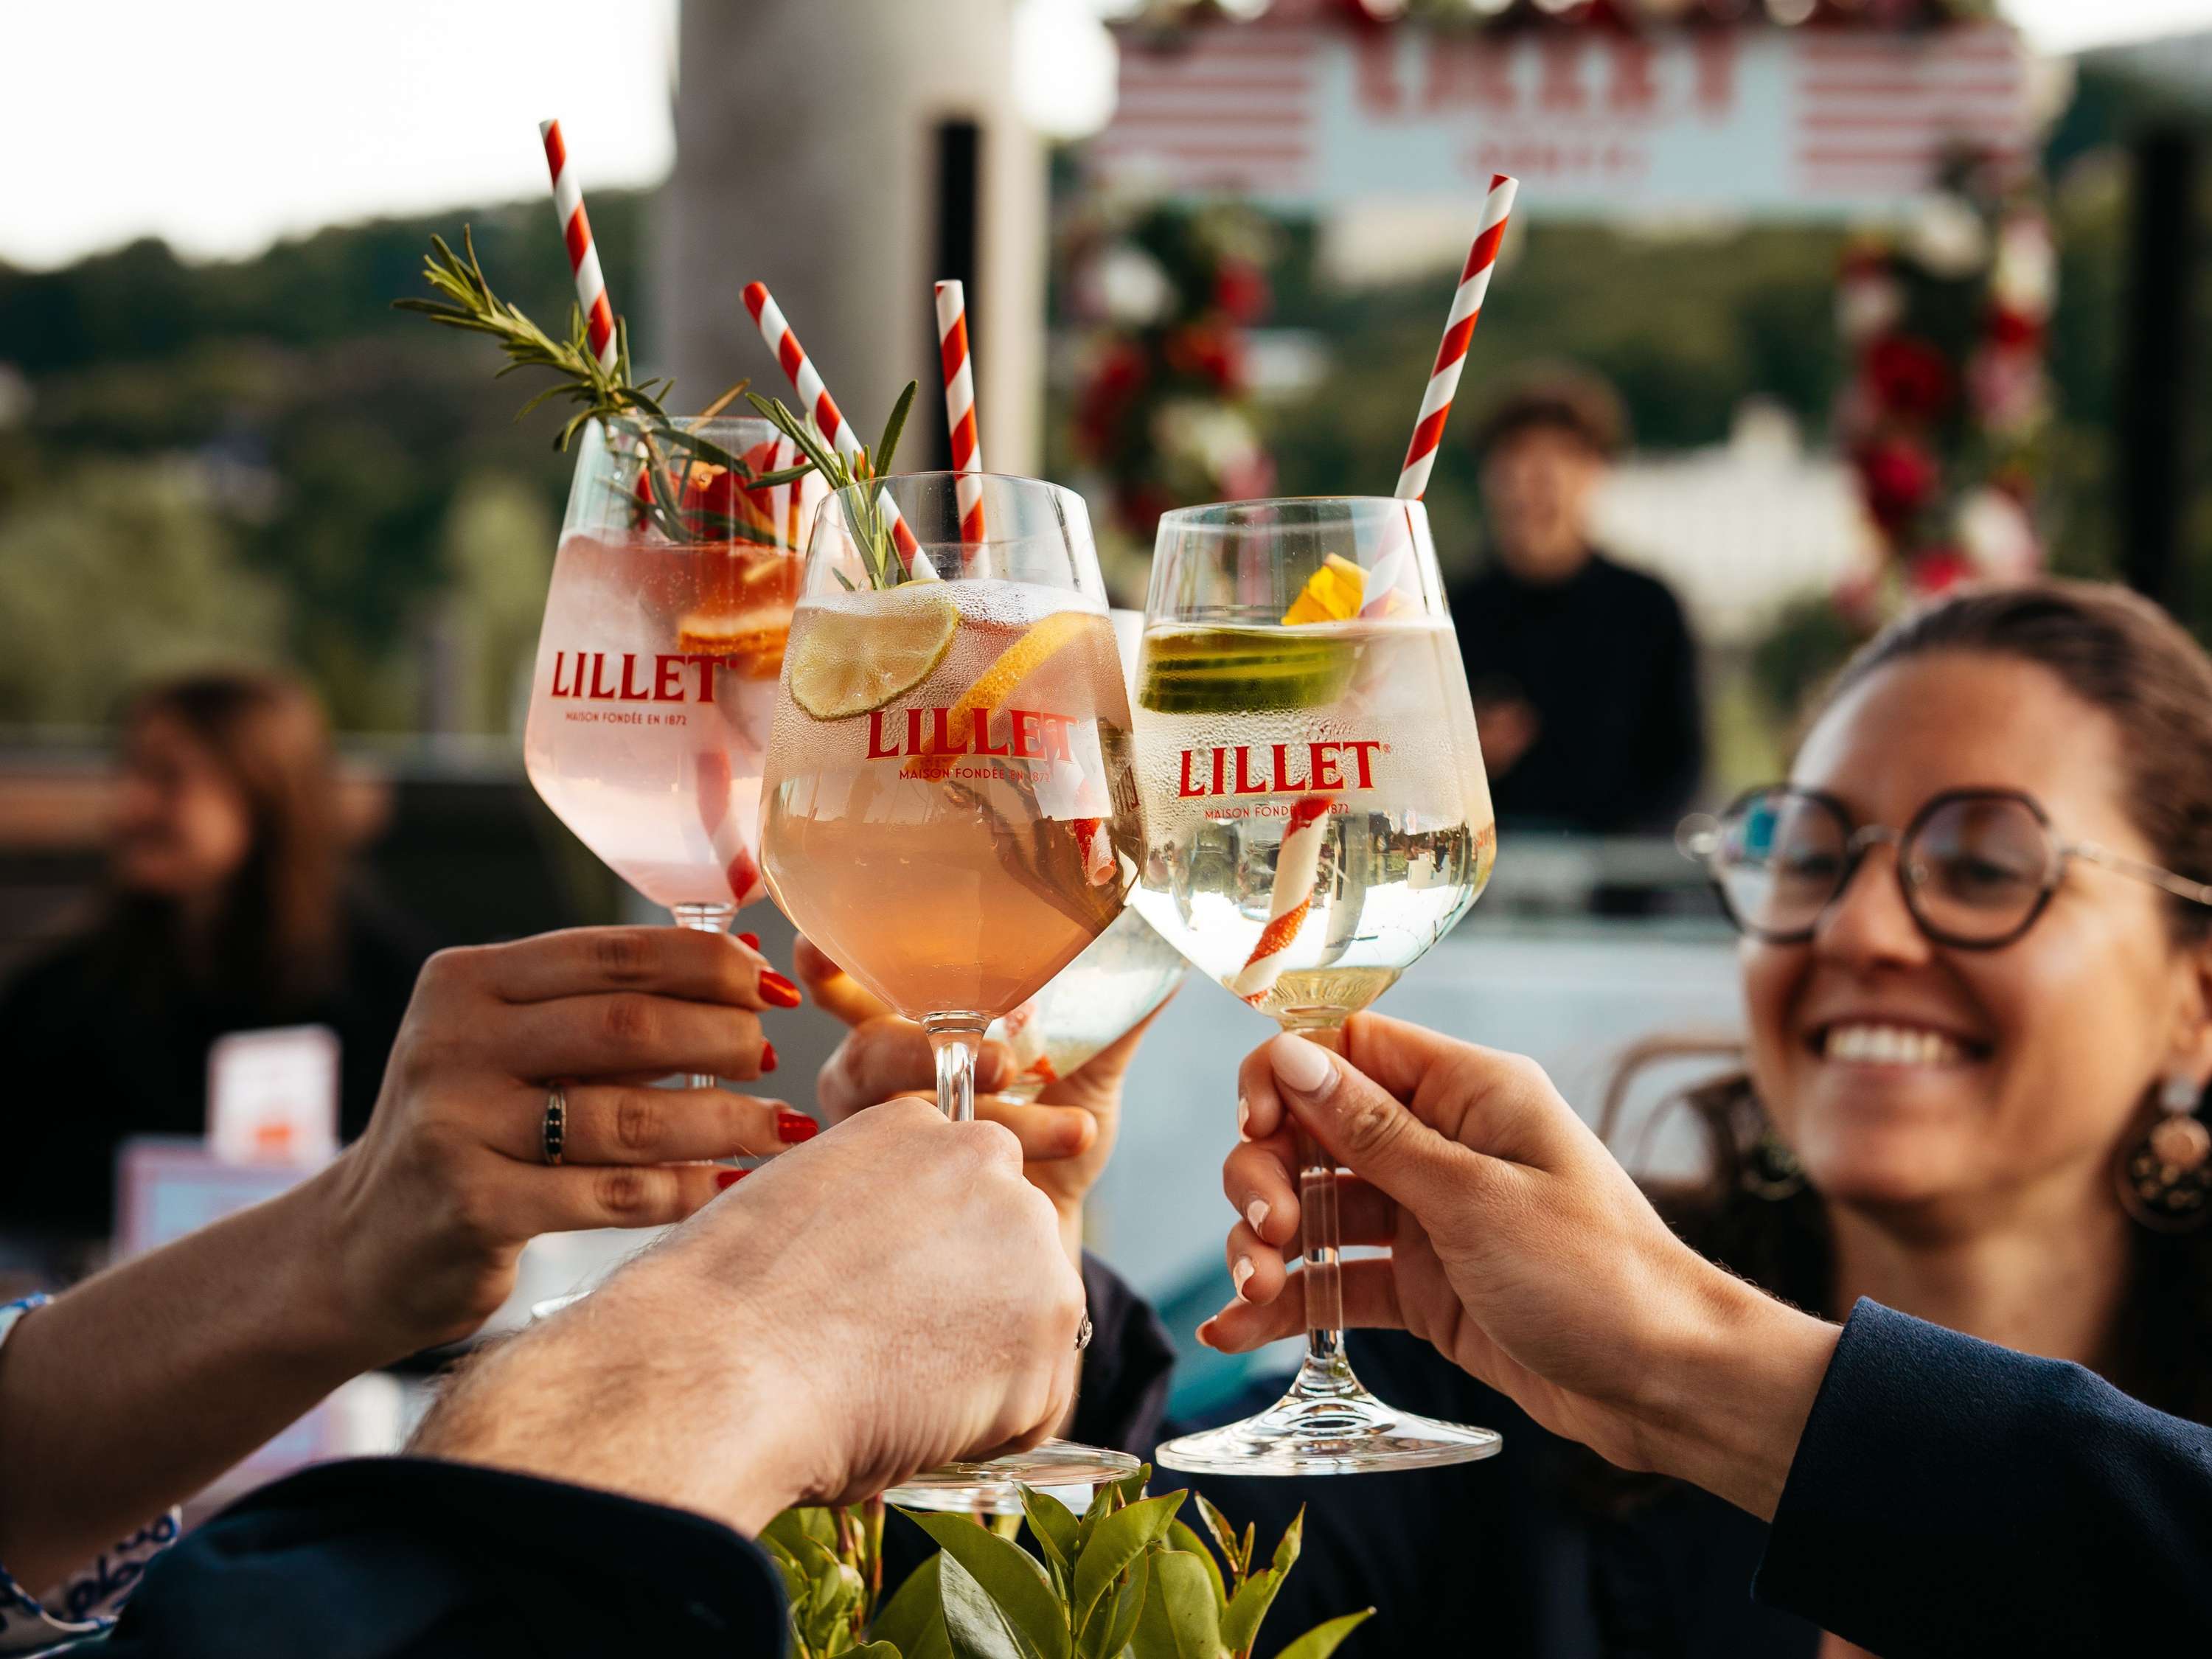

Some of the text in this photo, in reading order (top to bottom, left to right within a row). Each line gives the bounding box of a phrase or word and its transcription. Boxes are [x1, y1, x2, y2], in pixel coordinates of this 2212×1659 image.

[552, 651, 728, 703] LILLET
[566, 712, 687, 726] MAISON FONDÉE EN 1872
[866, 707, 1079, 764] LILLET
[899, 768, 950, 780] MAISON
[956, 767, 1004, 779] FONDÉE
[1010, 770, 1023, 780] EN
[1178, 741, 1380, 798] LILLET
[1205, 807, 1250, 819] MAISON
[1255, 803, 1304, 817] FONDÉ
